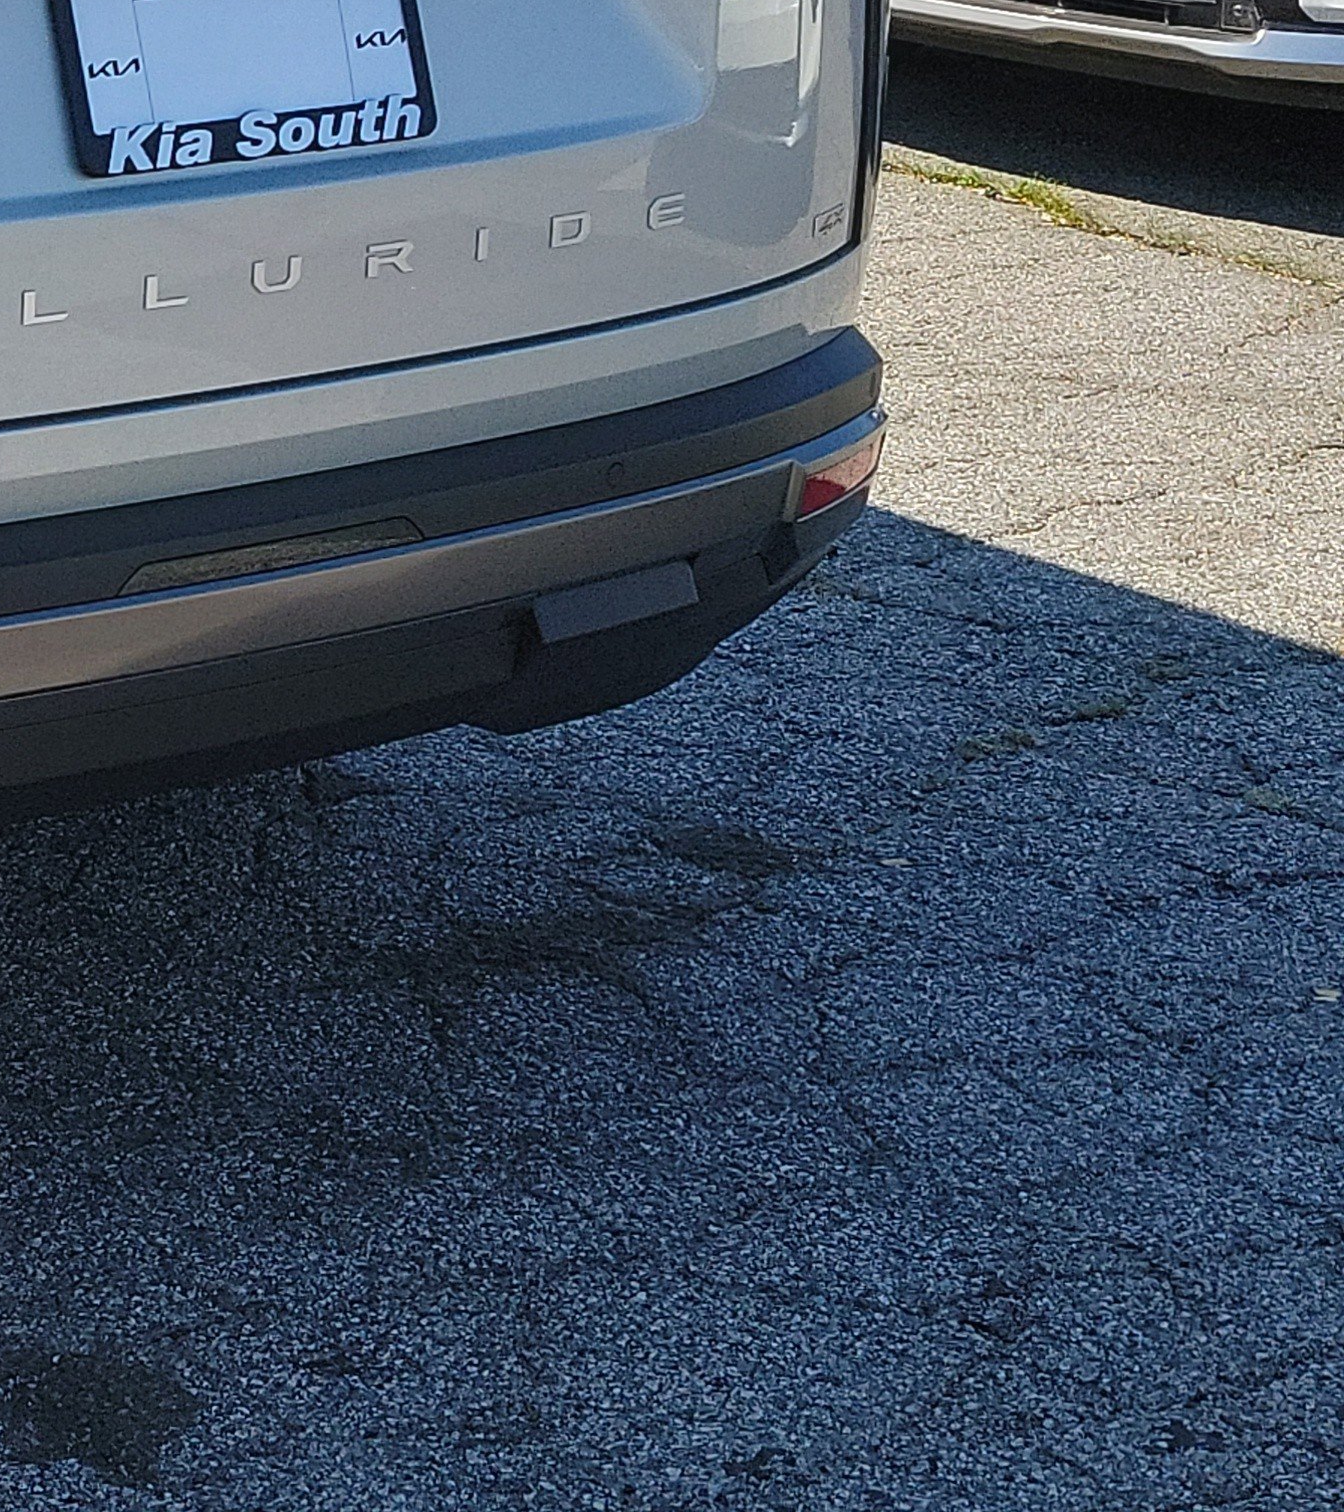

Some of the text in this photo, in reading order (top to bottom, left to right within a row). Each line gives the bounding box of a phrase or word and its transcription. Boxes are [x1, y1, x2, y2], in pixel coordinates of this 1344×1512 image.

[355, 28, 406, 50] KIA
[88, 57, 140, 80] KIA
[108, 92, 422, 175] Kia South
